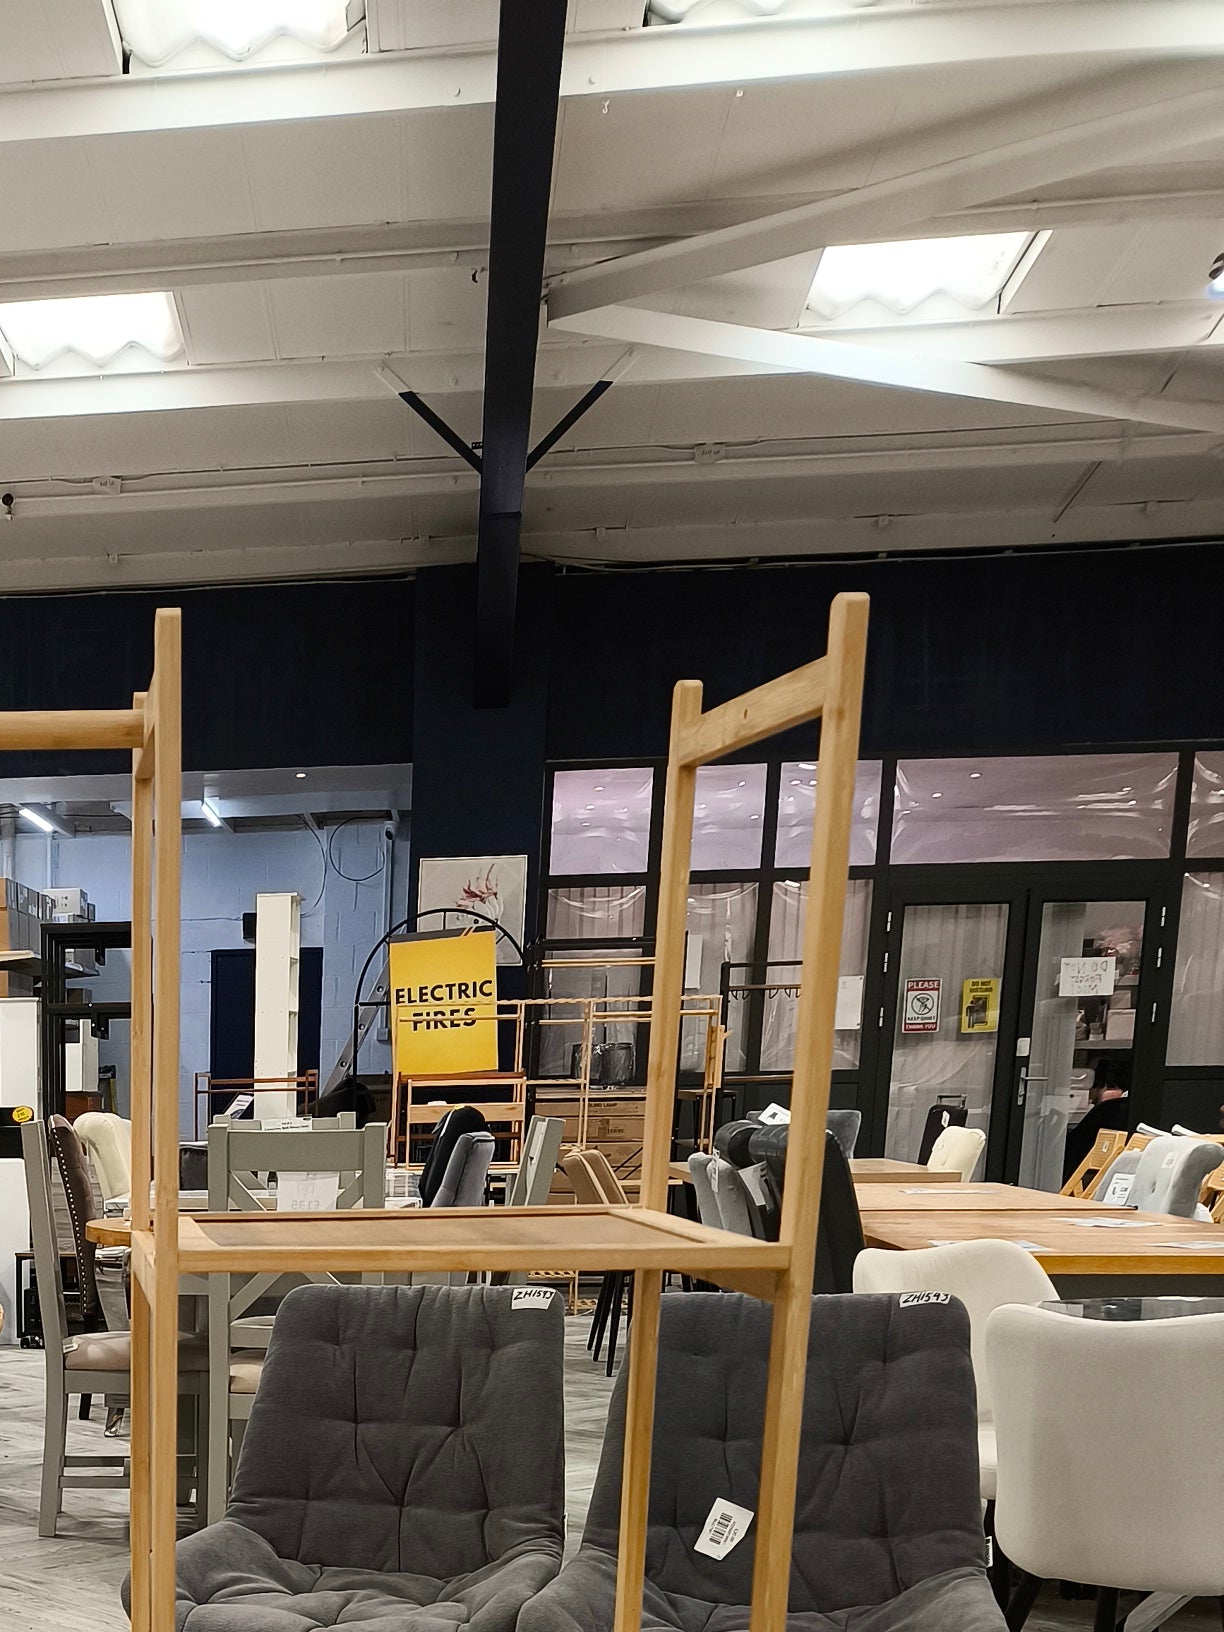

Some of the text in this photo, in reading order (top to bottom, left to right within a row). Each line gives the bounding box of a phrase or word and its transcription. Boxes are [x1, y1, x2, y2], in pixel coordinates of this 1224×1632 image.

[908, 981, 940, 989] PLEASE
[395, 980, 493, 1004] ELECTRIC
[412, 1007, 476, 1031] FIRES
[514, 1290, 554, 1300] ZH1593
[902, 1292, 950, 1303] ZH1593
